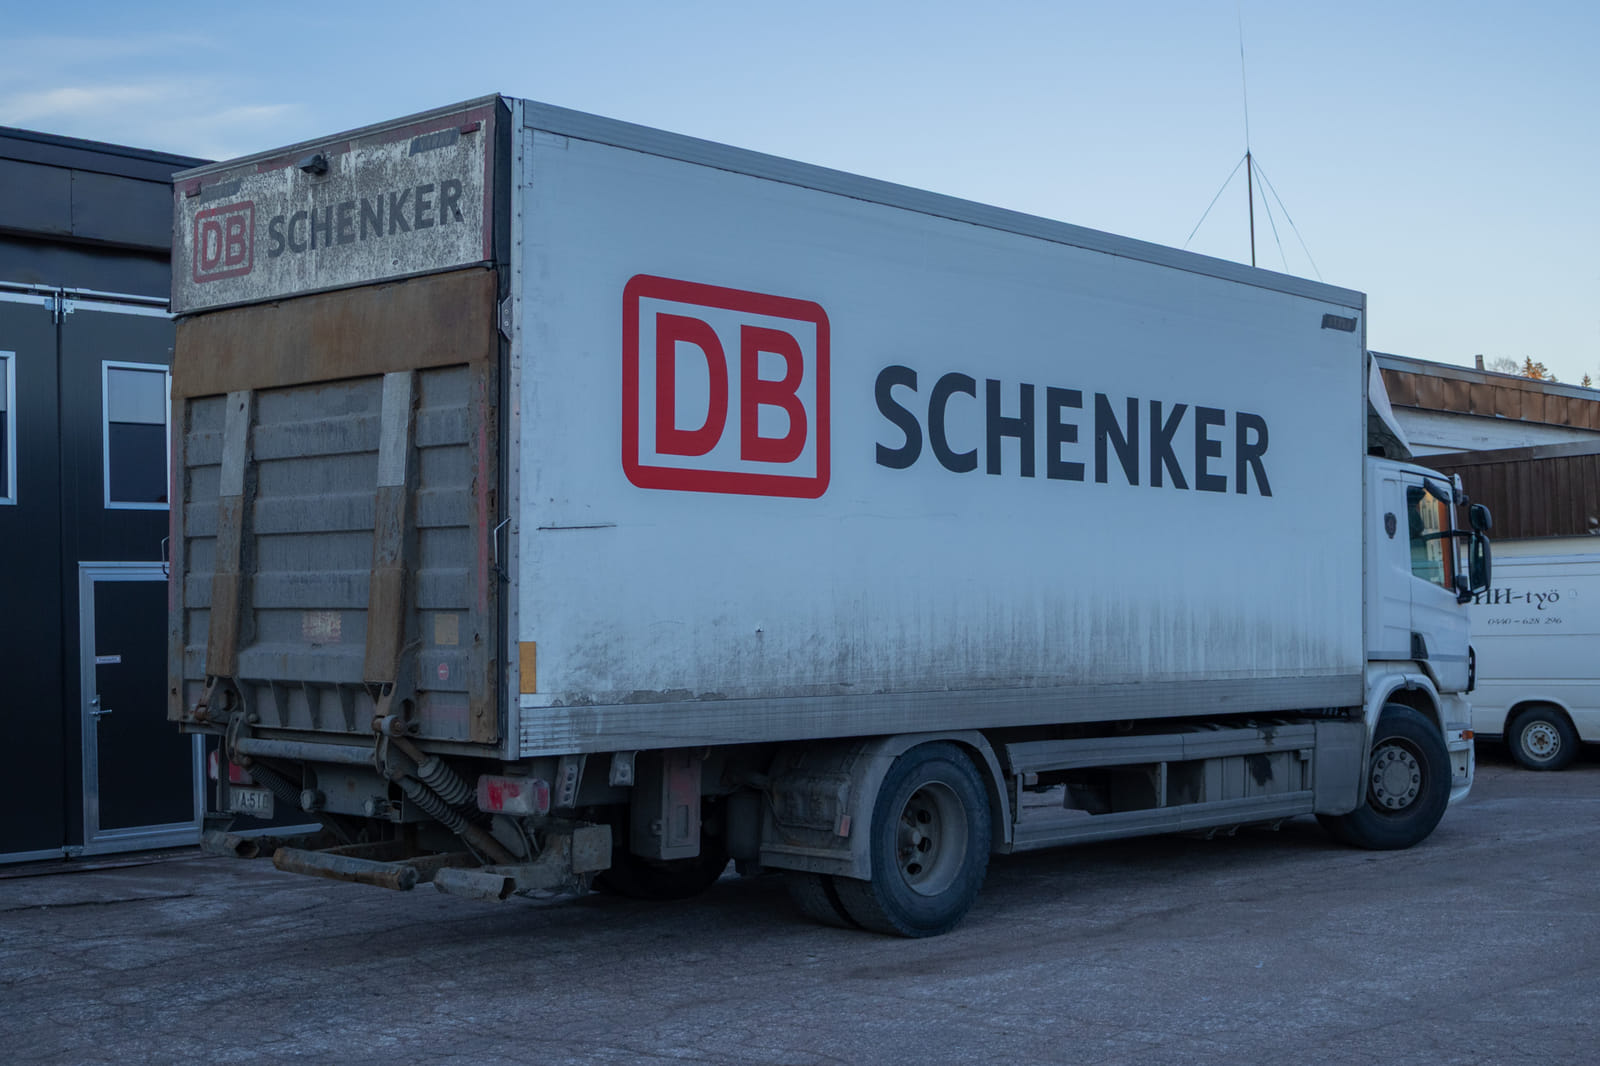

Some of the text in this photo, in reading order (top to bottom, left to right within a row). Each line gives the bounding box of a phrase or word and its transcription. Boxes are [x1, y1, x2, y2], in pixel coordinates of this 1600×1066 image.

[201, 178, 465, 271] DB SCHENKER
[655, 312, 1273, 498] DB SCHENKER
